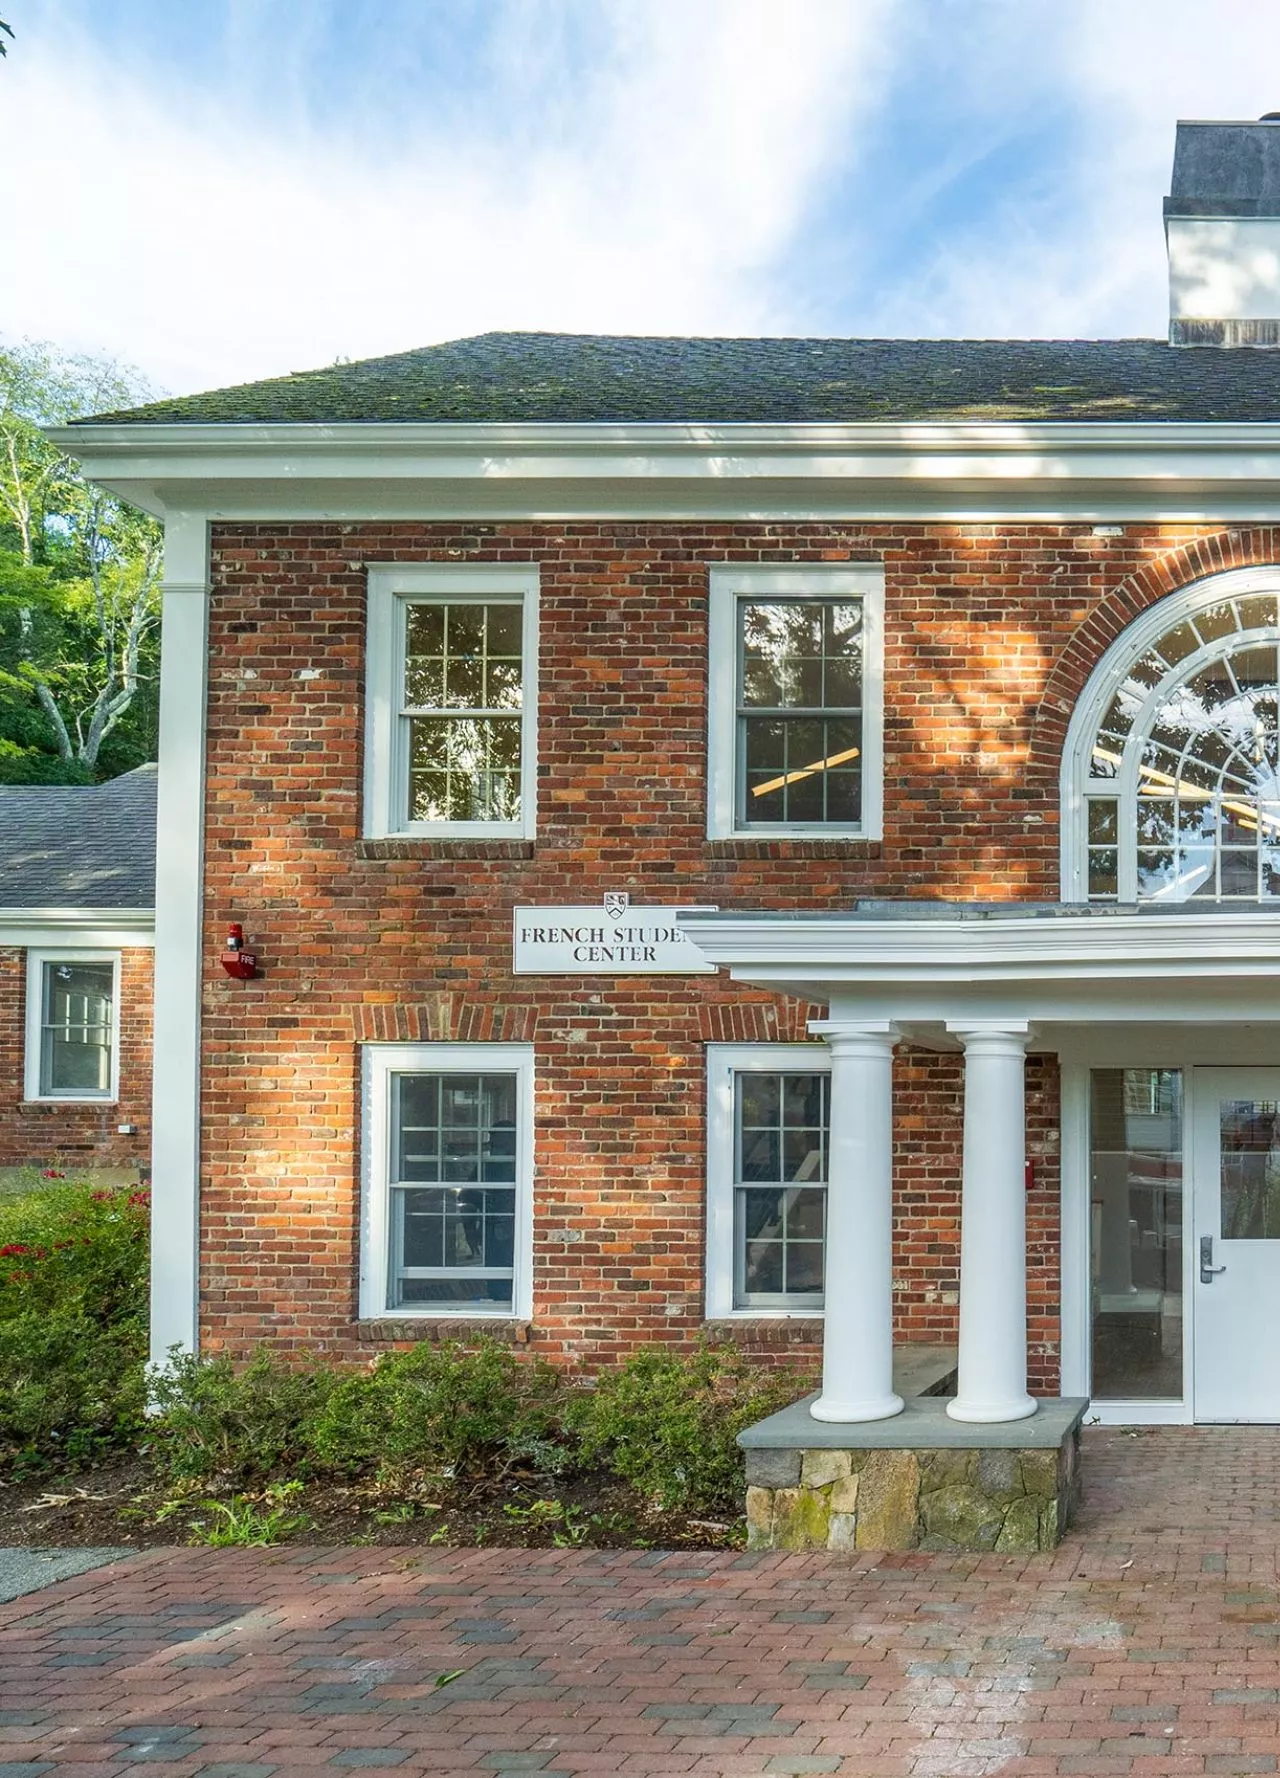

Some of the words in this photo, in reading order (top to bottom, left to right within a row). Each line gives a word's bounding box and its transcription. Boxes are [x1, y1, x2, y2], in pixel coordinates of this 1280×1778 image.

[521, 928, 604, 943] FRENCH
[241, 954, 255, 966] FIRE
[573, 946, 657, 962] CENTER
